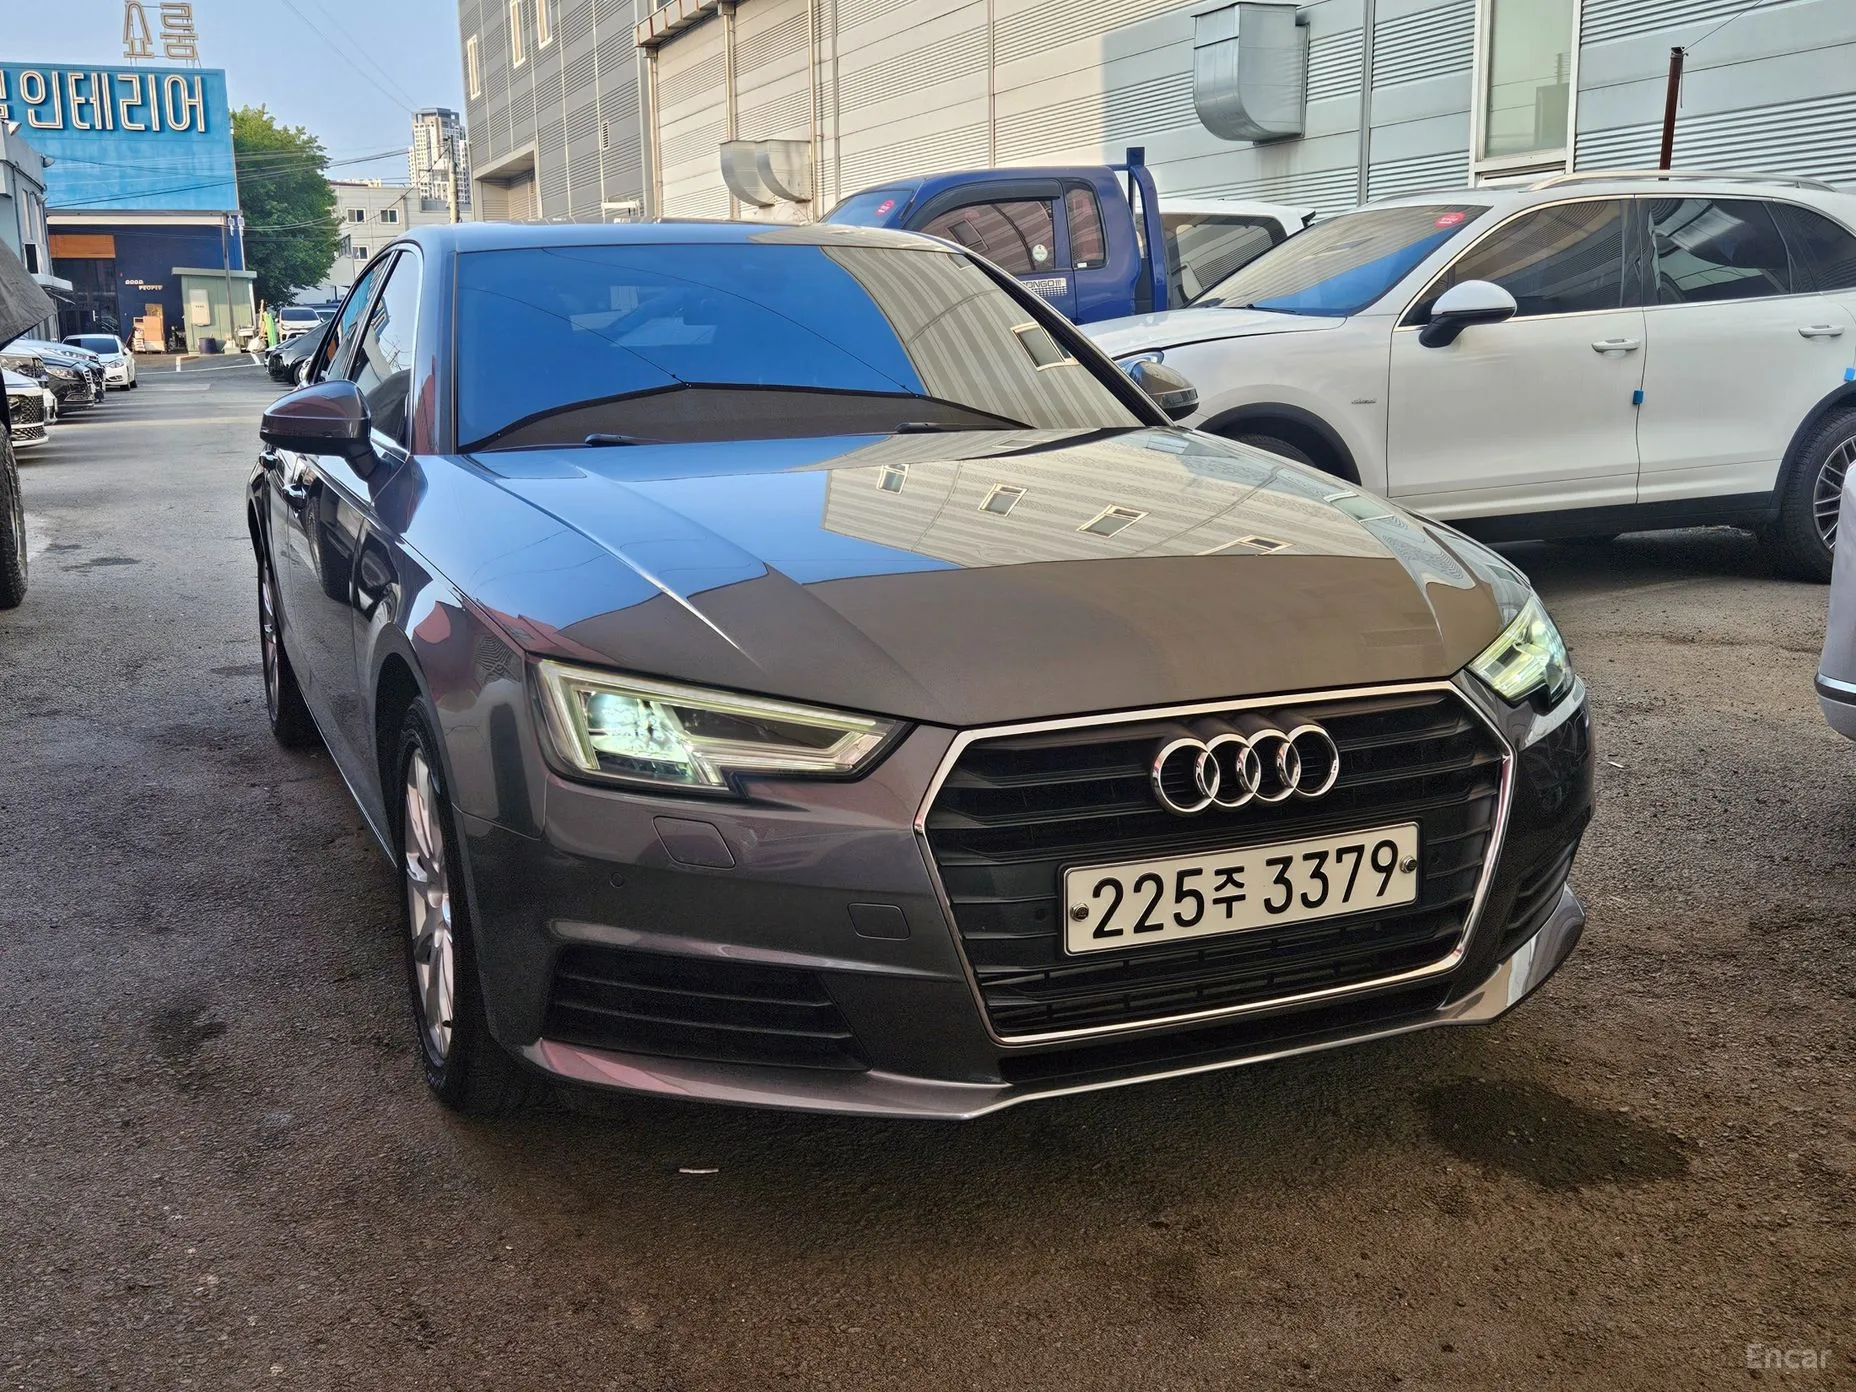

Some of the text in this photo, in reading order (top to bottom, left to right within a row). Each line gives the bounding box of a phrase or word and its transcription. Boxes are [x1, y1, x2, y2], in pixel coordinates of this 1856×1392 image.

[0, 70, 206, 132] 인테리어
[1023, 280, 1055, 288] ONGO
[1092, 839, 1399, 939] 225주 3379
